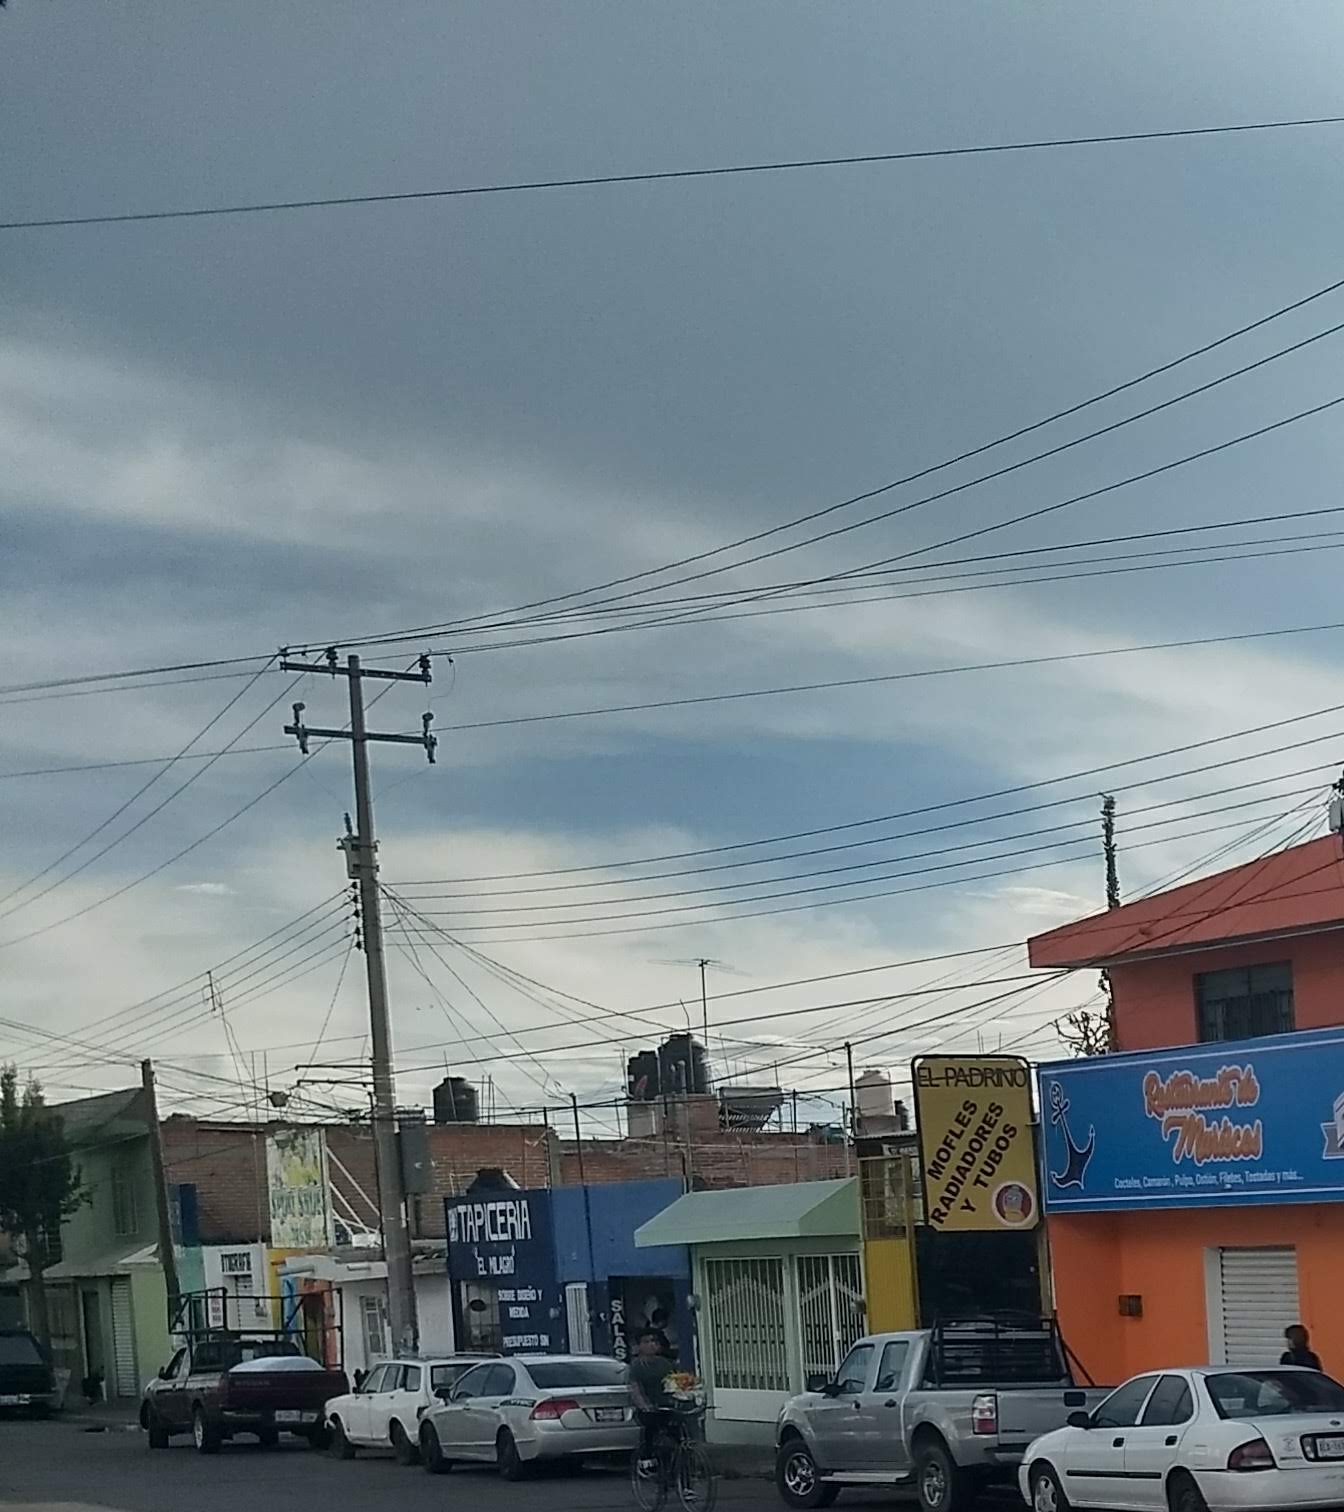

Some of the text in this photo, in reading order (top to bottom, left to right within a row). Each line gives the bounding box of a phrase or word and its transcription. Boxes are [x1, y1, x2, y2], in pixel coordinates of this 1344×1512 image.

[917, 1067, 1028, 1087] EL PADRINO
[927, 1100, 978, 1180] MOFLES
[931, 1102, 1004, 1224] RADIADORES
[960, 1123, 1018, 1214] Y TUBOS
[457, 1200, 532, 1243] TAPICERIA
[478, 1257, 487, 1275] EL
[610, 1299, 627, 1360] SALAS
